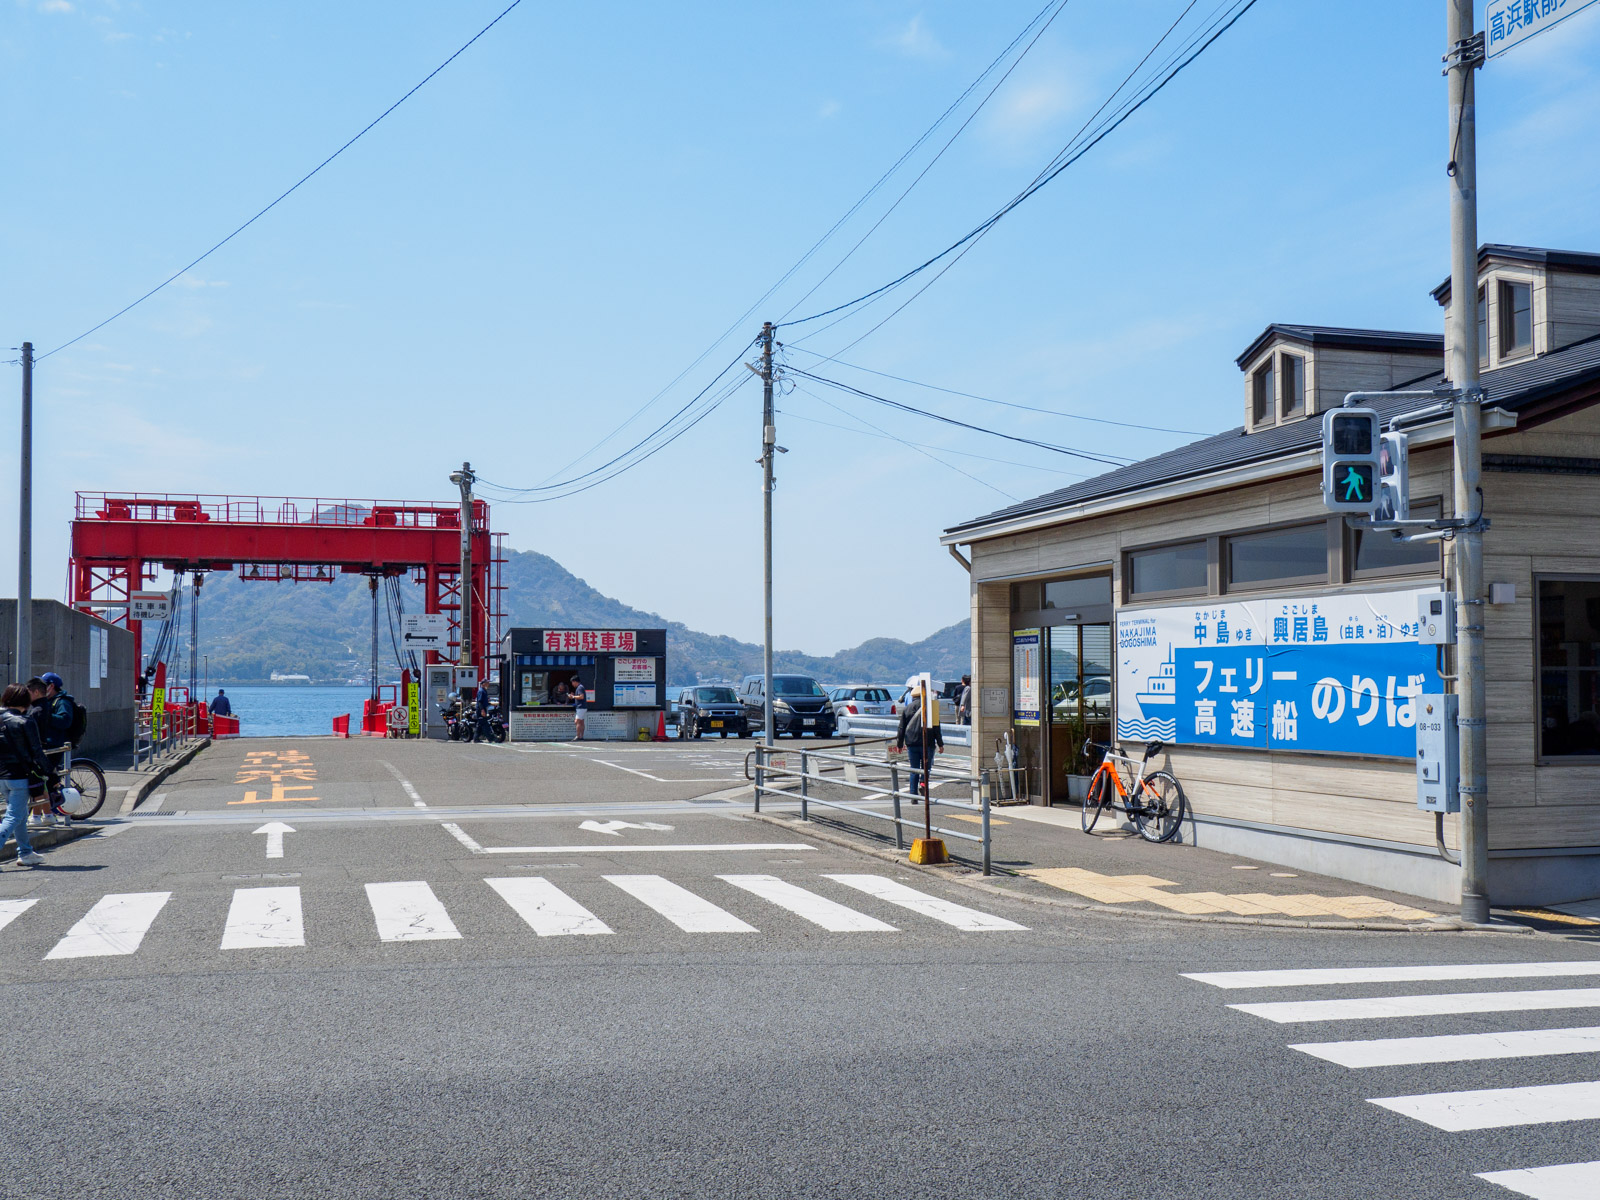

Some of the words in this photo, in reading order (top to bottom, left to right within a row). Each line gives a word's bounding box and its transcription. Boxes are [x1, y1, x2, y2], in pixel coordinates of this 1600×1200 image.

[1490, 0, 1566, 45] 高浜駅前
[135, 602, 167, 610] 駐車場
[1195, 609, 1226, 621] なかじま
[1120, 627, 1157, 638] NAKAJIMA
[545, 631, 634, 651] 有料駐車場
[1120, 637, 1157, 648] GOGOSHIMA
[1194, 657, 1297, 694] フェリー
[1311, 673, 1426, 728] のりば
[1194, 698, 1298, 741] 高速船
[1419, 722, 1441, 732] 08-033
